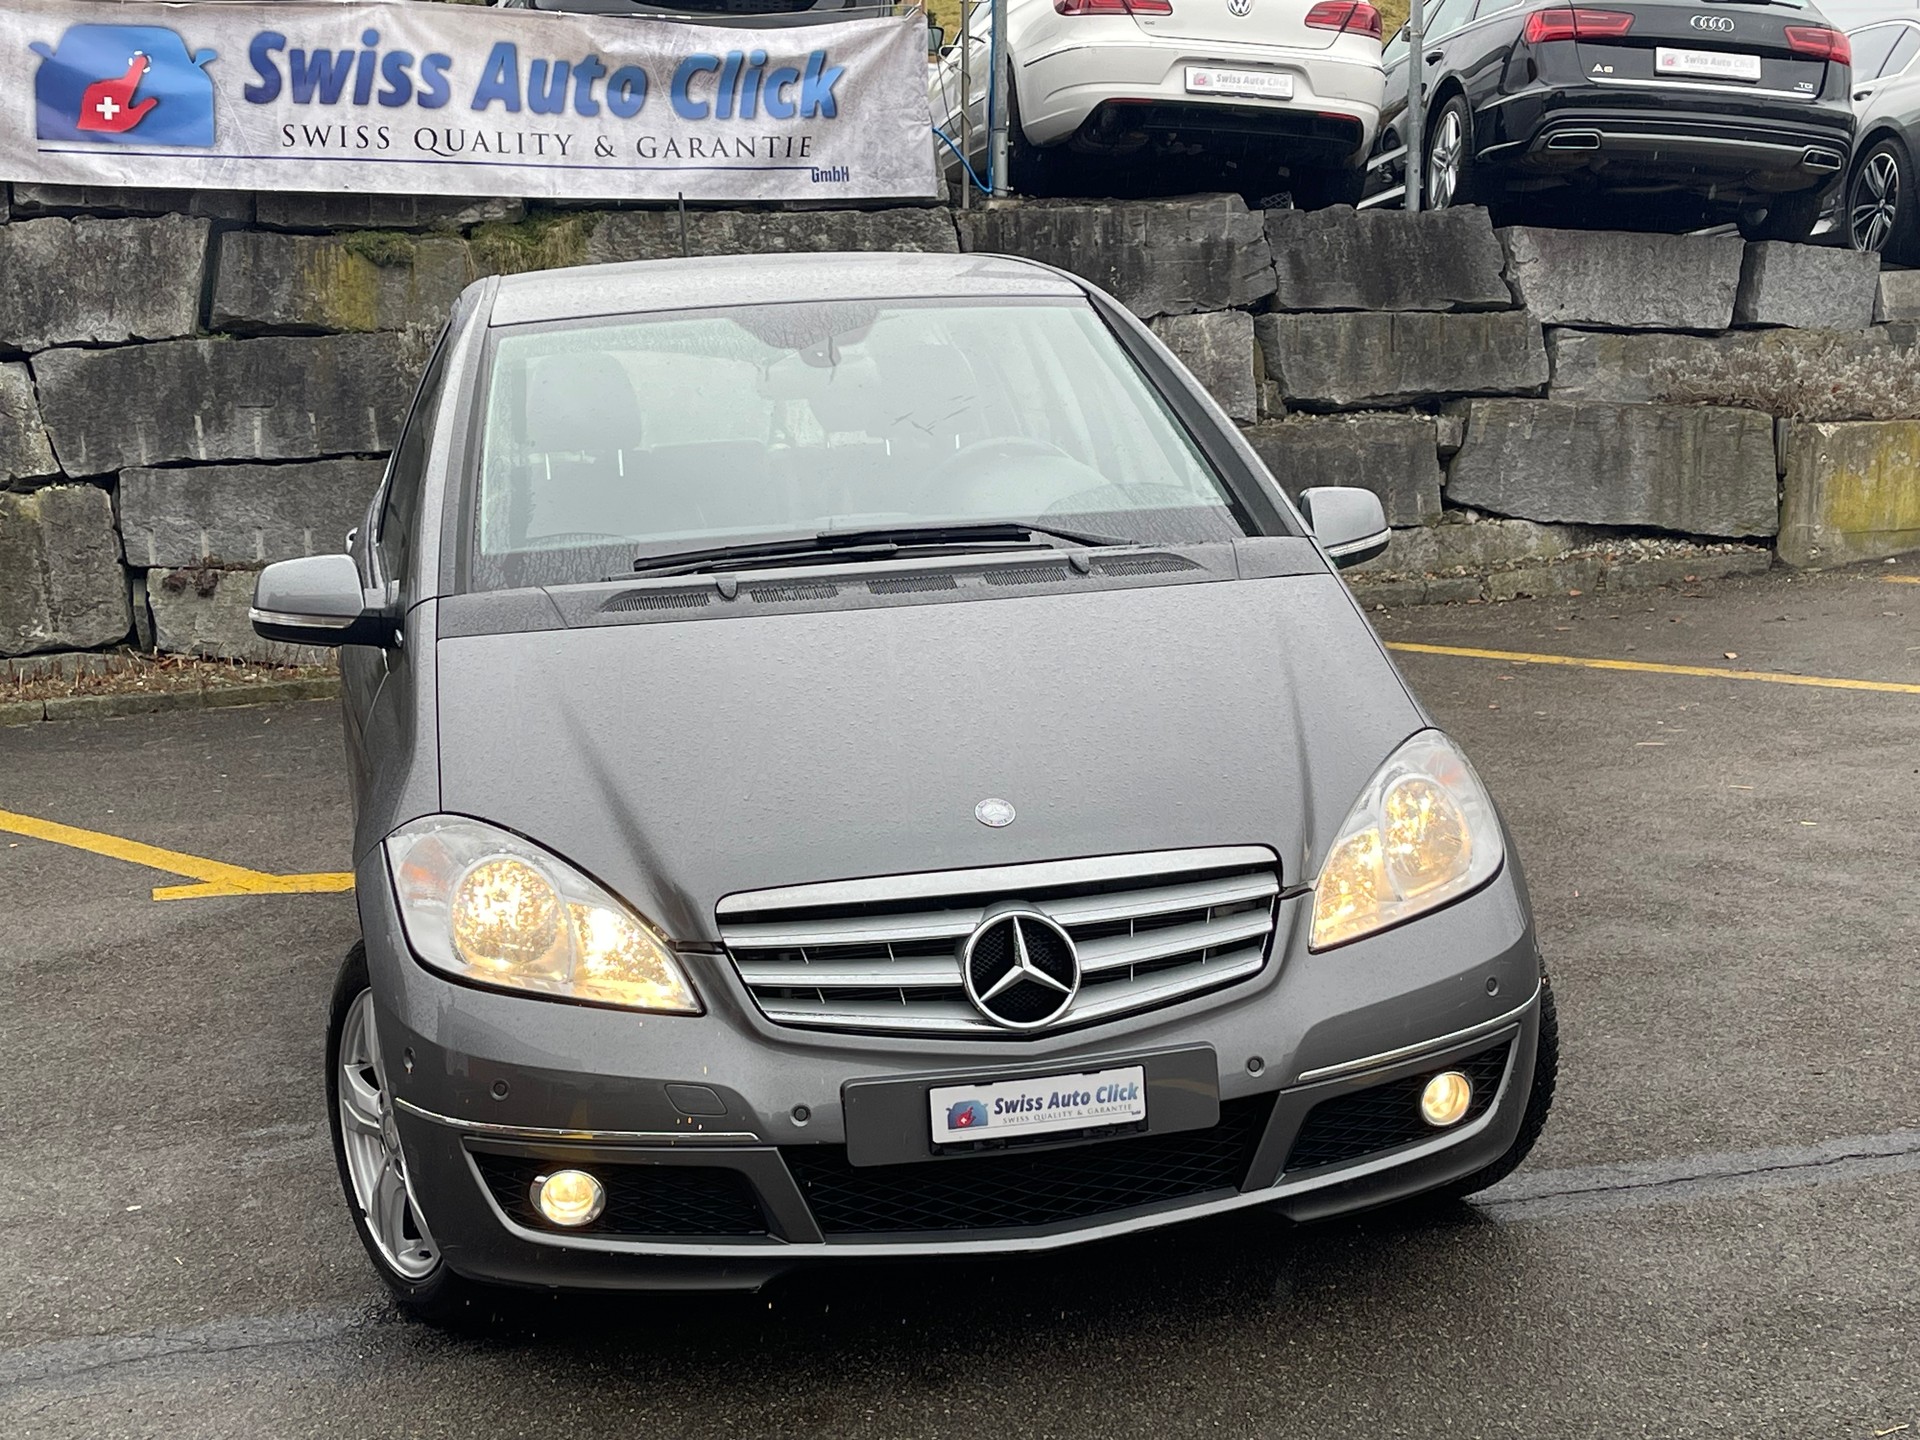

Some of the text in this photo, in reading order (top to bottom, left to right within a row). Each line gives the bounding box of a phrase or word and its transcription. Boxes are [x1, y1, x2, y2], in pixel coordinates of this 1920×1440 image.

[1684, 54, 1708, 65] Swiss
[1711, 56, 1732, 67] Auto
[244, 28, 845, 120] Swiss Auto Click
[1216, 73, 1240, 84] Swiss
[1243, 75, 1265, 86] Auto
[282, 124, 812, 159] SWISS QUALITY & GARANTIE
[811, 166, 849, 183] GmbH
[994, 1082, 1139, 1115] Swiss Auto Click
[1003, 1115, 1030, 1125] SWISS
[1034, 1110, 1073, 1122] QUALITY
[1088, 1103, 1132, 1115] GARANTIE
